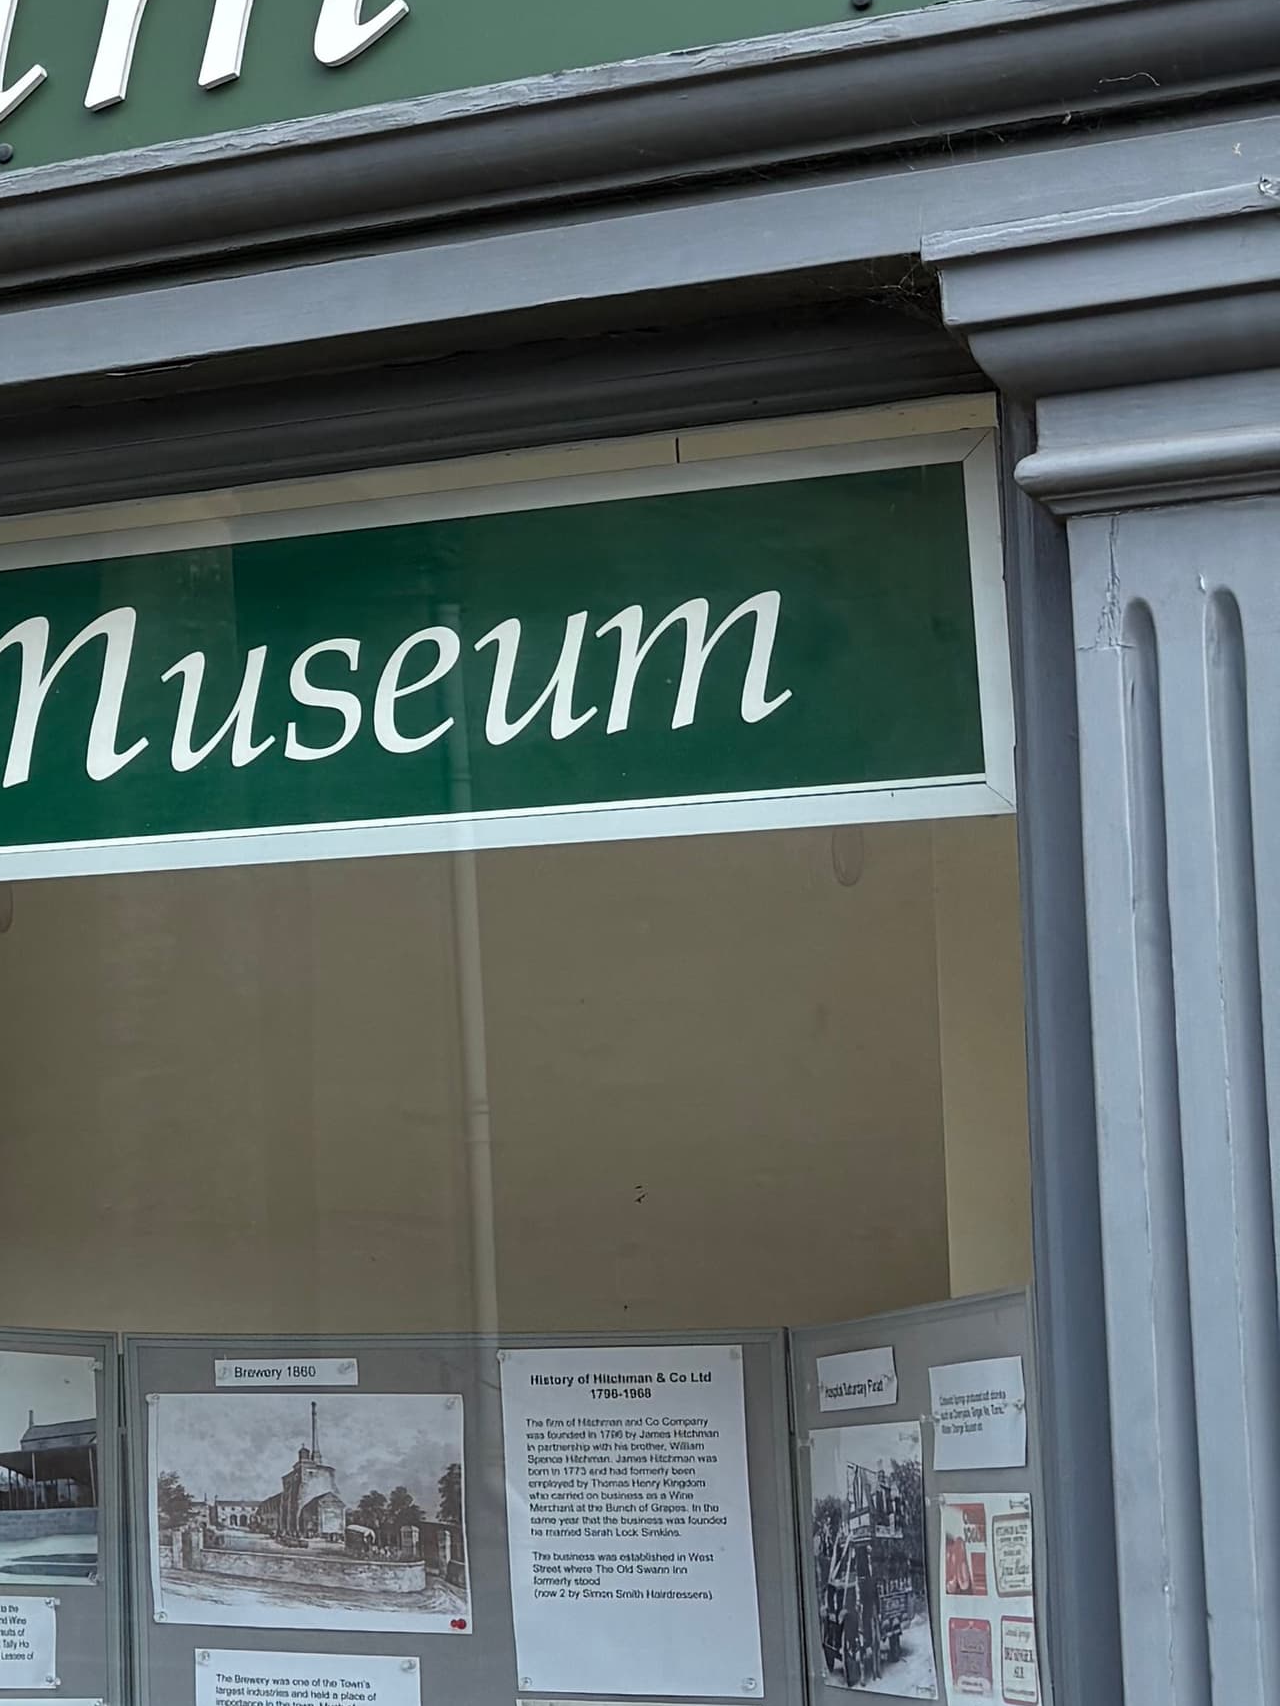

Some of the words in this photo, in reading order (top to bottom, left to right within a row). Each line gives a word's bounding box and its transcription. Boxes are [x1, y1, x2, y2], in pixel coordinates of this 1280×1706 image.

[234, 1366, 282, 1379] Brewery
[530, 1374, 574, 1386] History
[577, 1373, 589, 1384] of
[593, 1373, 652, 1383] Hitchman
[656, 1372, 665, 1382] &
[669, 1372, 687, 1382] Co
[690, 1371, 711, 1382] Ltd
[215, 1673, 233, 1682] The
[234, 1674, 270, 1685] Brewery
[311, 1678, 320, 1686] of
[322, 1678, 338, 1687] the
[339, 1678, 371, 1688] Town's
[215, 1686, 245, 1696] largest
[246, 1687, 289, 1697] industries
[290, 1689, 309, 1698] and
[310, 1690, 330, 1699] held
[340, 1691, 365, 1700] place
[366, 1692, 376, 1701] of
